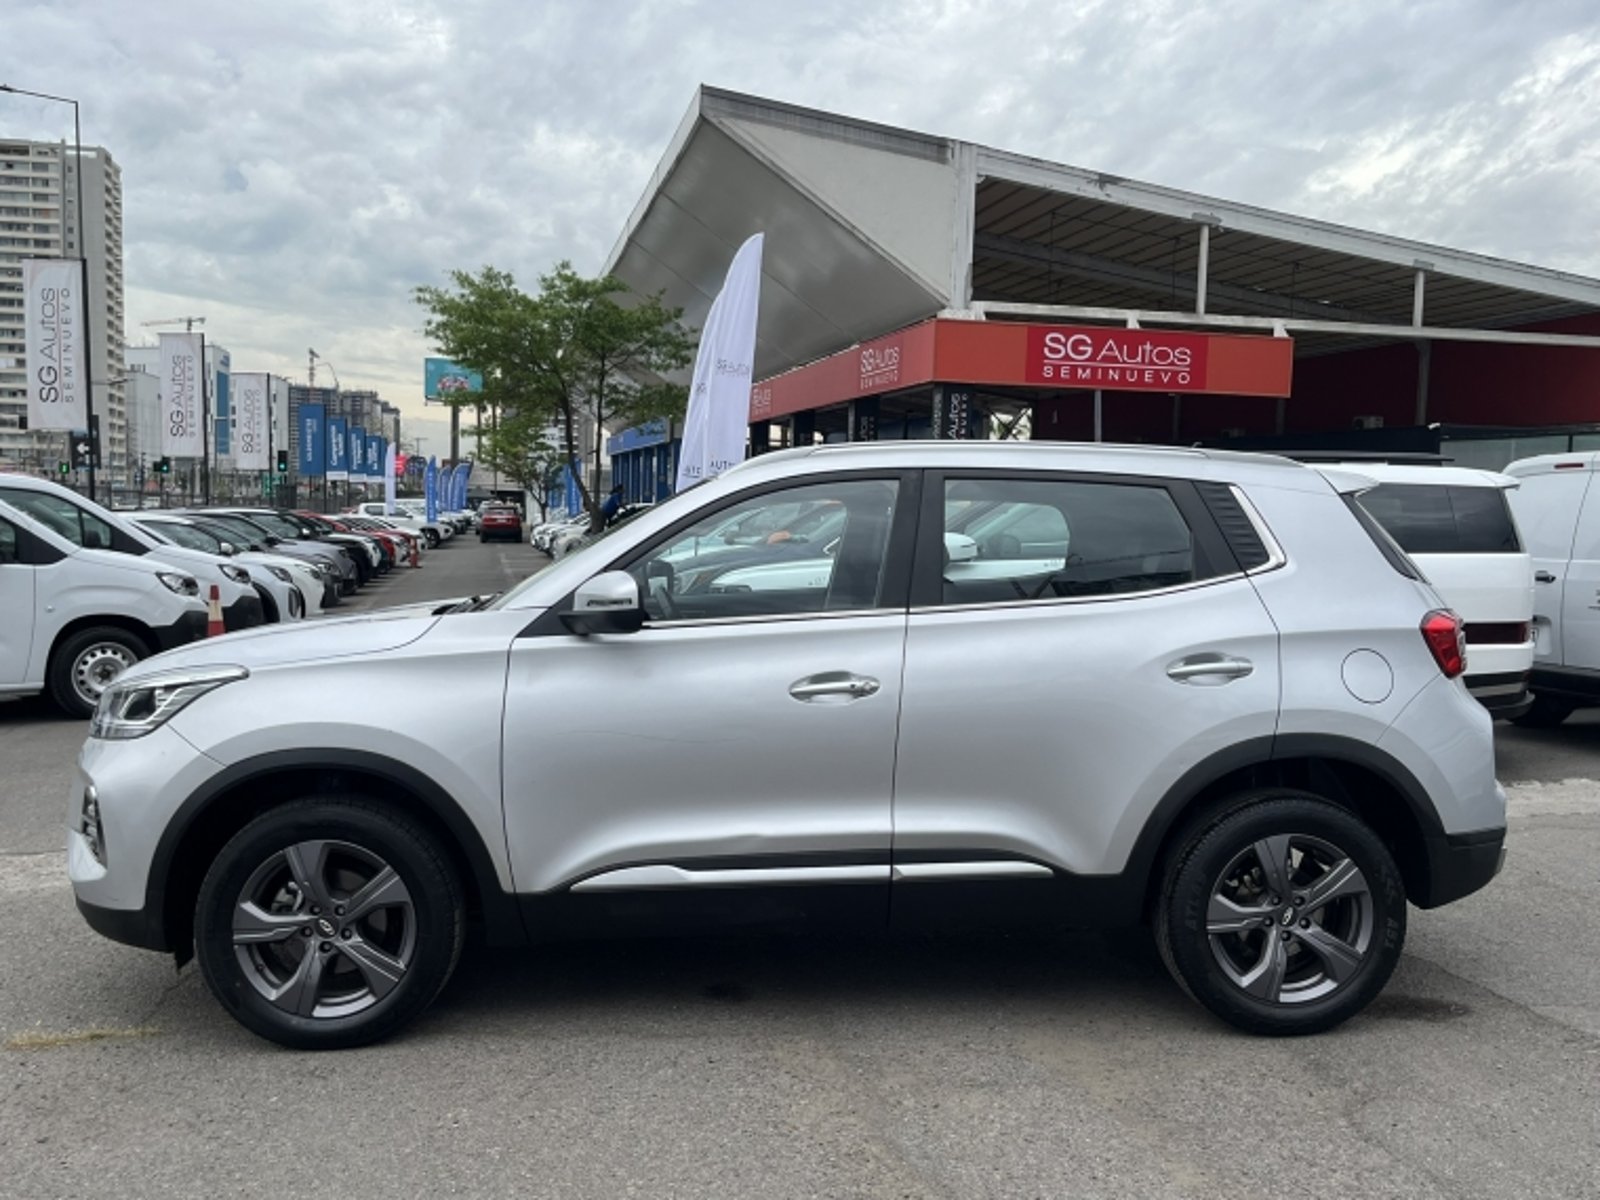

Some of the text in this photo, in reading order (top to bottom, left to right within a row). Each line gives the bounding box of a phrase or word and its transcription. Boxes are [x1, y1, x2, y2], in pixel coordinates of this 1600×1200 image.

[37, 288, 59, 403] SG Autos
[60, 287, 75, 403] SEMINUEVO
[1043, 332, 1192, 365] SG Autos
[1042, 365, 1191, 384] SEMINUEVO
[170, 409, 185, 437] SG
